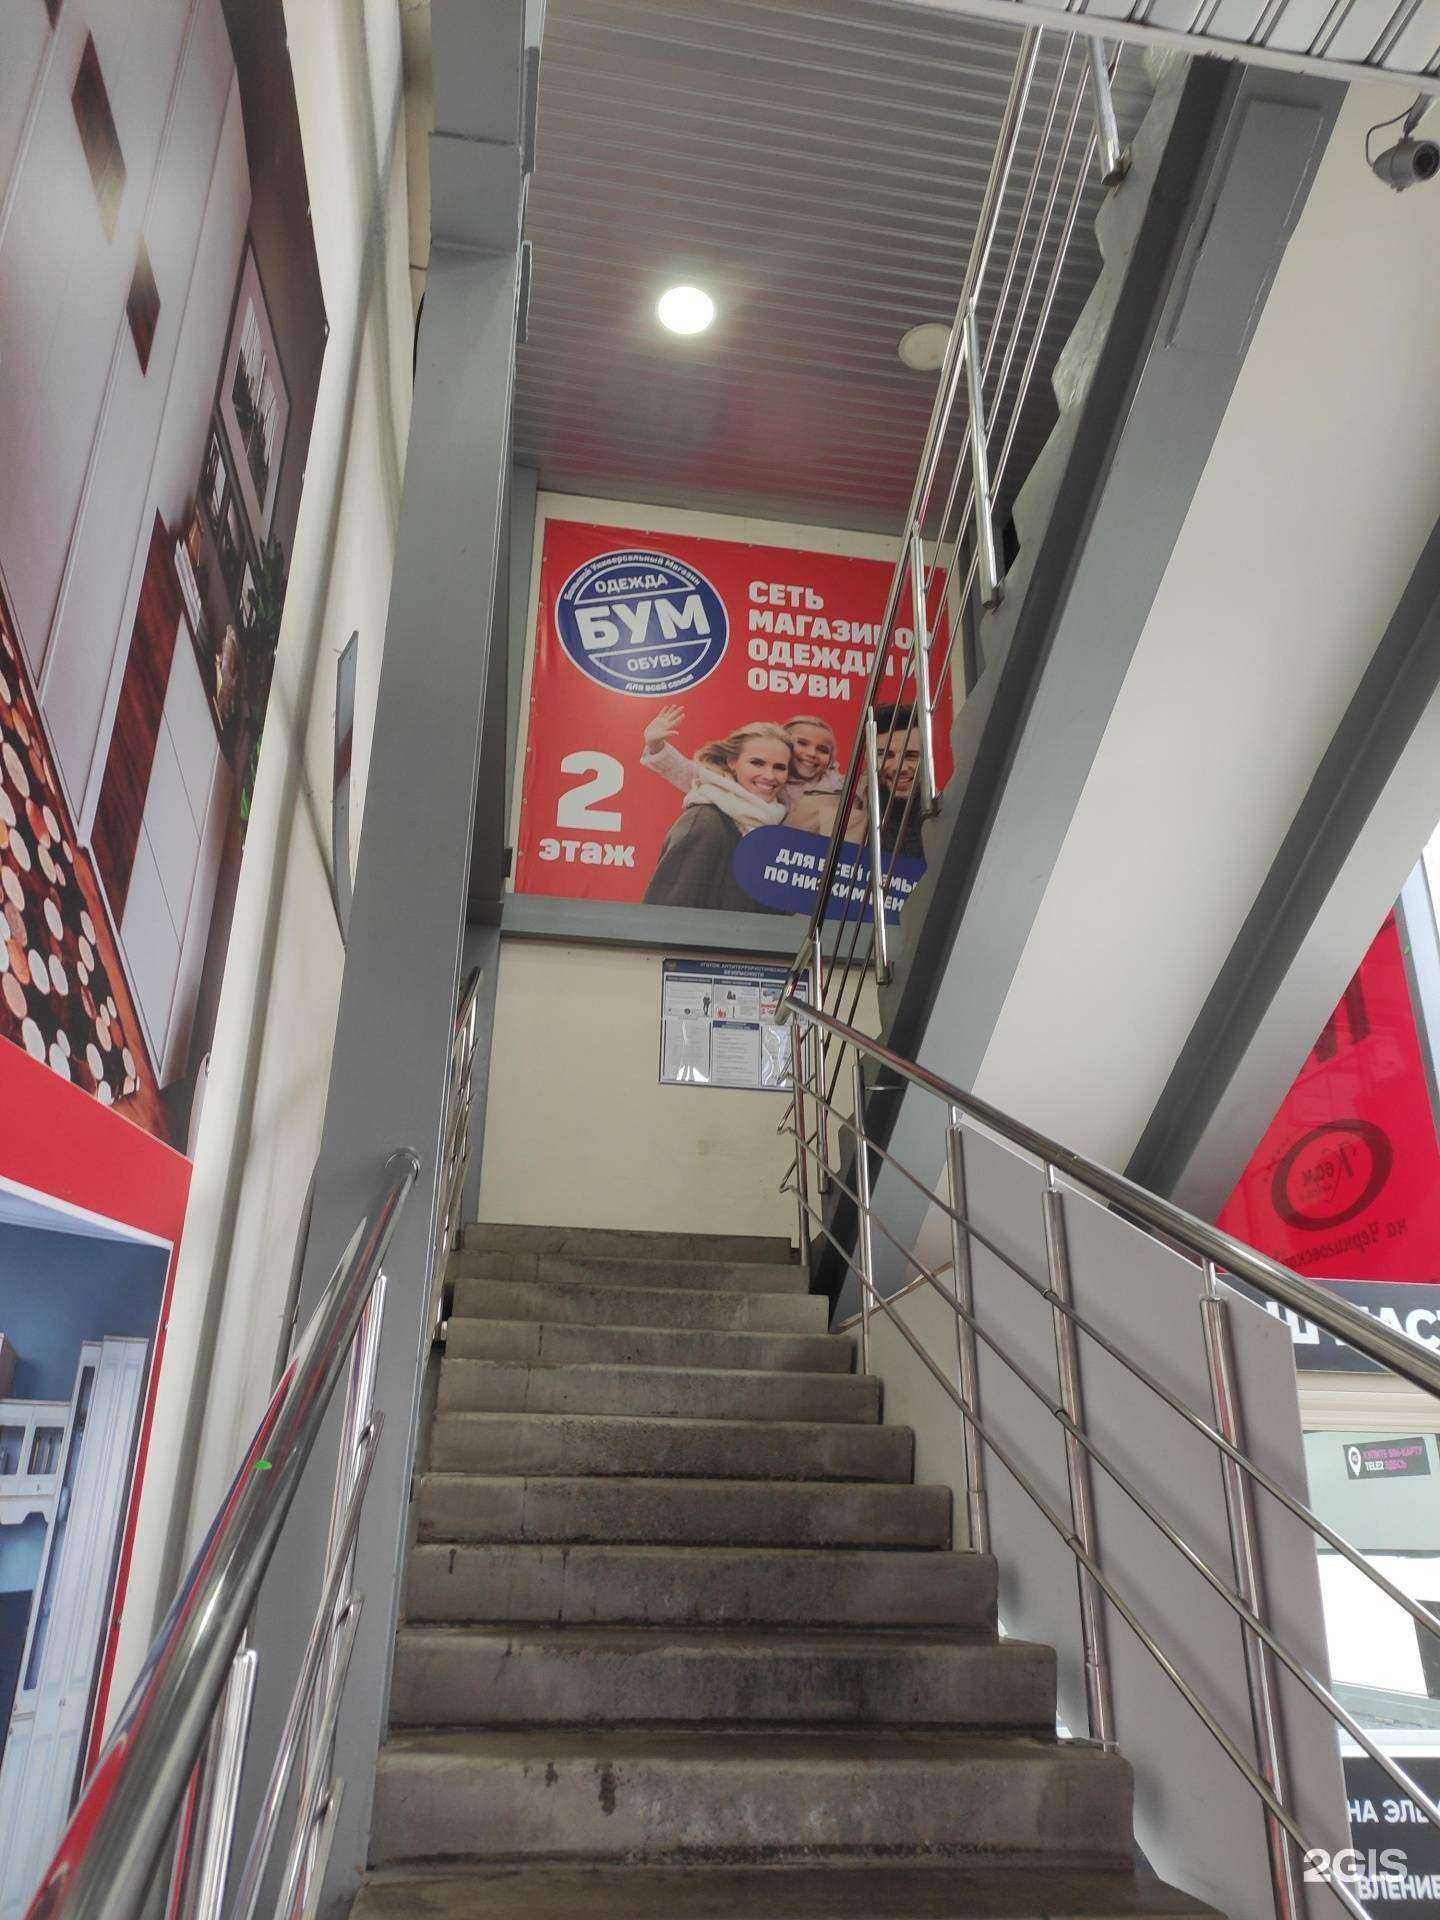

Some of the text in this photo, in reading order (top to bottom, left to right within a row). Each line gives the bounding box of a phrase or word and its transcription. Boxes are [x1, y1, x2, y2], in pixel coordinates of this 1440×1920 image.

[594, 574, 669, 594] ОДЕЖДА
[748, 580, 825, 611] СЕТЬ
[574, 594, 711, 651] БУМ
[626, 654, 682, 672] ОБУВЬ
[747, 666, 850, 701] ОБУВИ
[557, 750, 625, 833] 2
[538, 837, 636, 868] этаж
[775, 848, 815, 870] ДЛЯ
[763, 865, 789, 884] ПО
